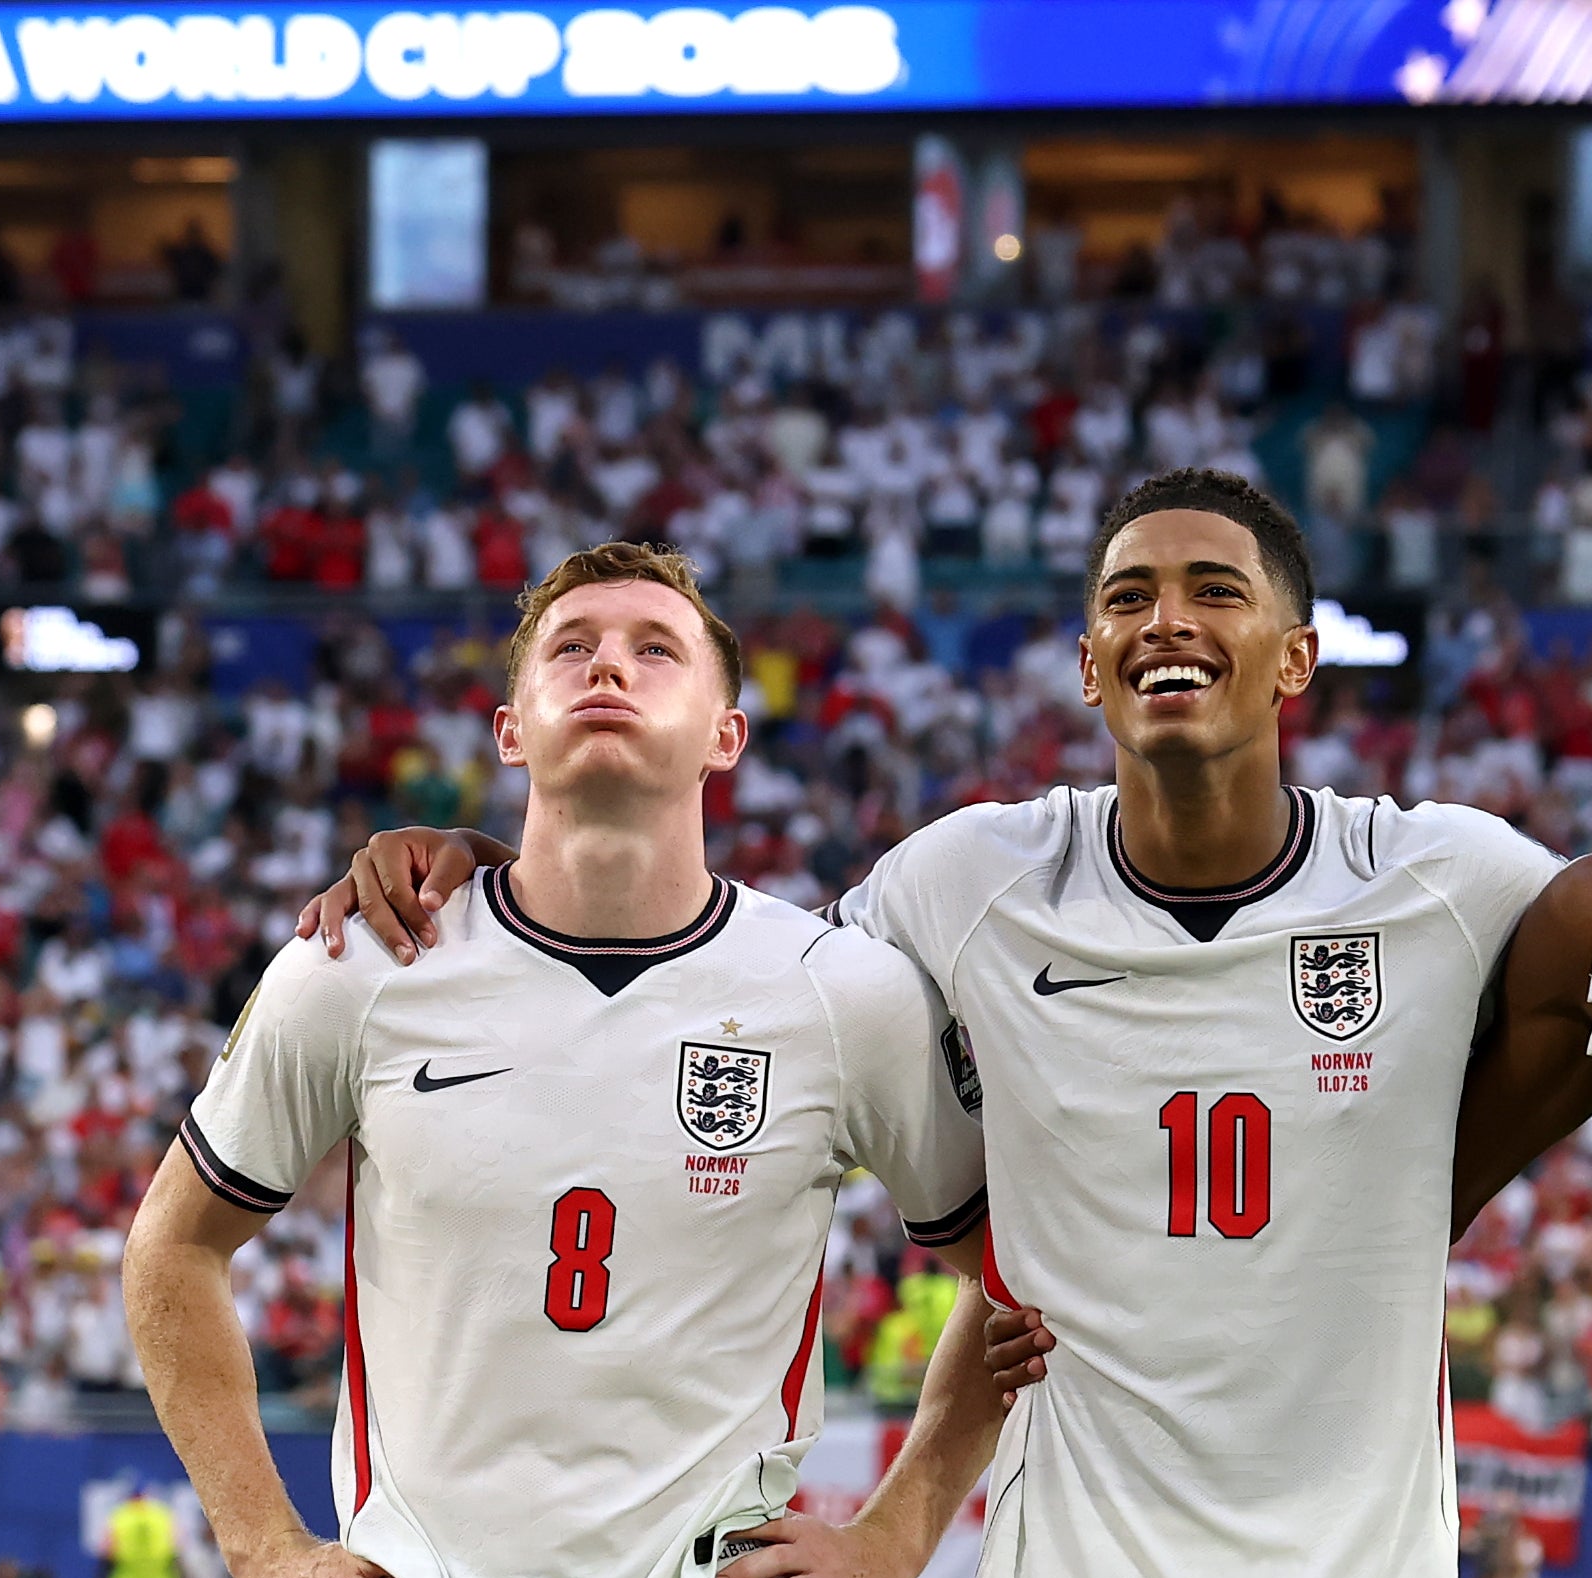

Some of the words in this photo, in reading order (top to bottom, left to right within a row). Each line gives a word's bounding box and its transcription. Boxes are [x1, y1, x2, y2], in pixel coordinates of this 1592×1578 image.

[18, 14, 363, 103] WORLD
[364, 11, 562, 100] CUP
[562, 5, 906, 97] 2026
[1310, 1052, 1375, 1071] NORWAY
[1317, 1074, 1370, 1093] 11.07.26
[684, 1154, 749, 1175] NORWAY
[1159, 1091, 1271, 1240] 10
[688, 1176, 742, 1197] 11.07.26
[543, 1186, 616, 1333] 8
